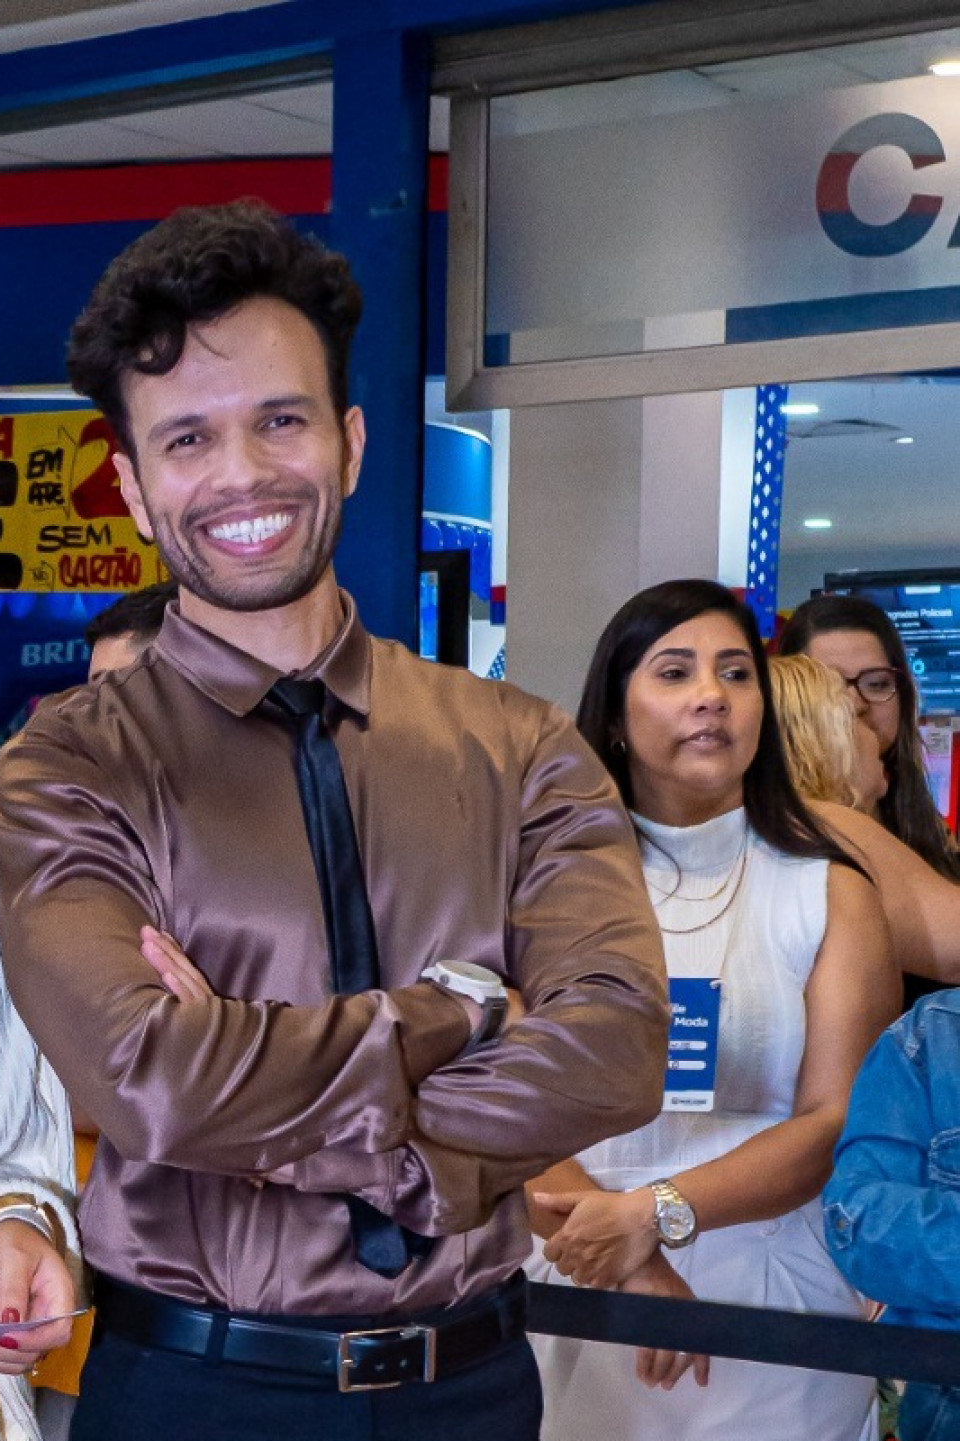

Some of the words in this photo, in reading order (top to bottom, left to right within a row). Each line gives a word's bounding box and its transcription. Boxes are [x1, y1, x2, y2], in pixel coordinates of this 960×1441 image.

[816, 112, 960, 258] C
[36, 523, 111, 553] SEM
[59, 546, 141, 587] CARTÃO
[674, 1017, 708, 1027] Moda
